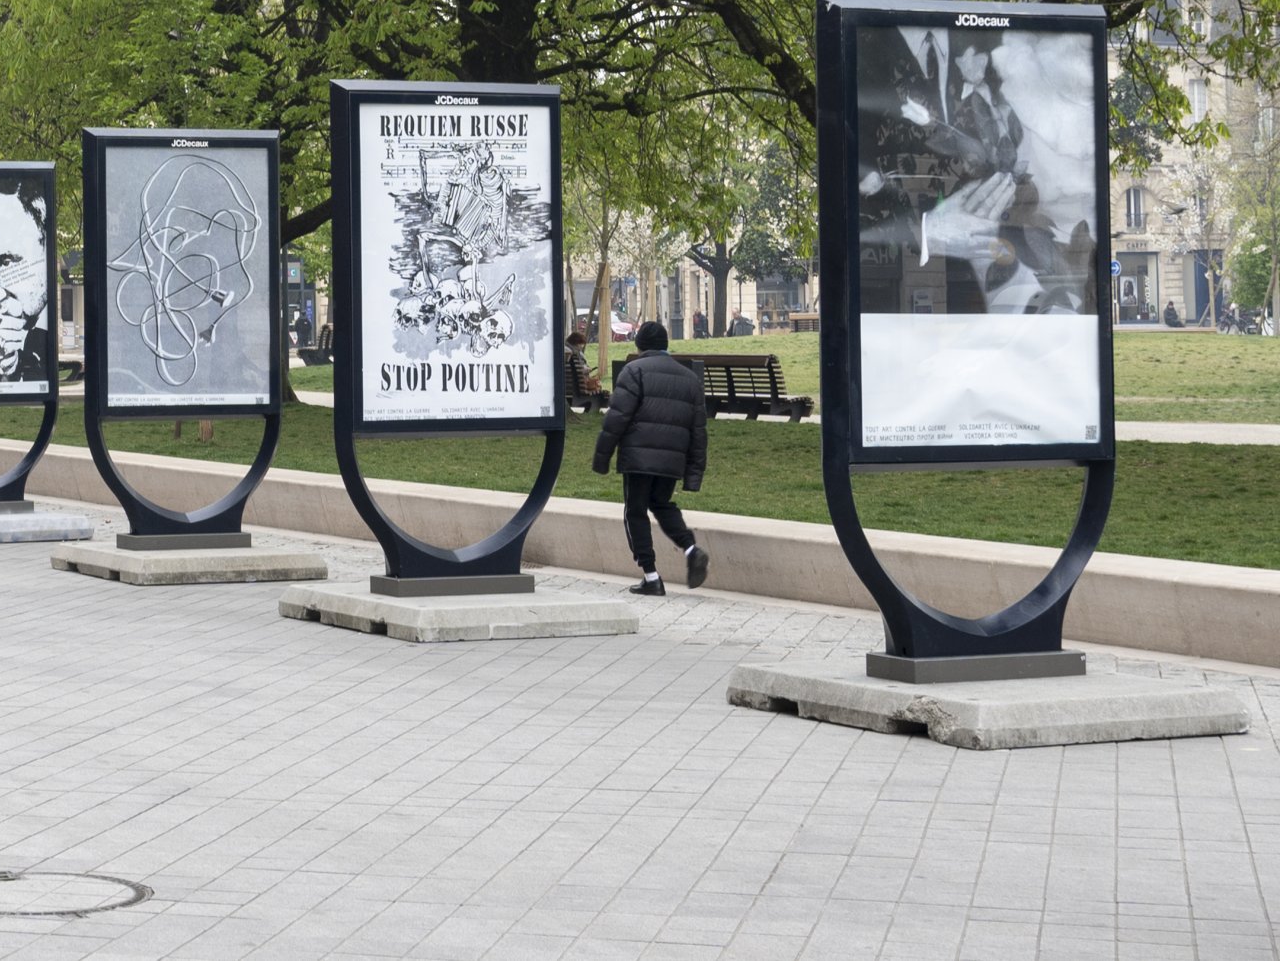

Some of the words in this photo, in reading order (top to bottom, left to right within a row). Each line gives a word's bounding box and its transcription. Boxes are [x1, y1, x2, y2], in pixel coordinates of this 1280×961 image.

[955, 14, 1010, 27] JCDecaux
[435, 95, 479, 105] JCDecaux
[380, 115, 462, 137] REQUIEM
[470, 114, 529, 137] RUSSE
[171, 139, 209, 148] JCDecaux
[380, 362, 432, 392] STOP
[441, 363, 530, 393] POUTINE
